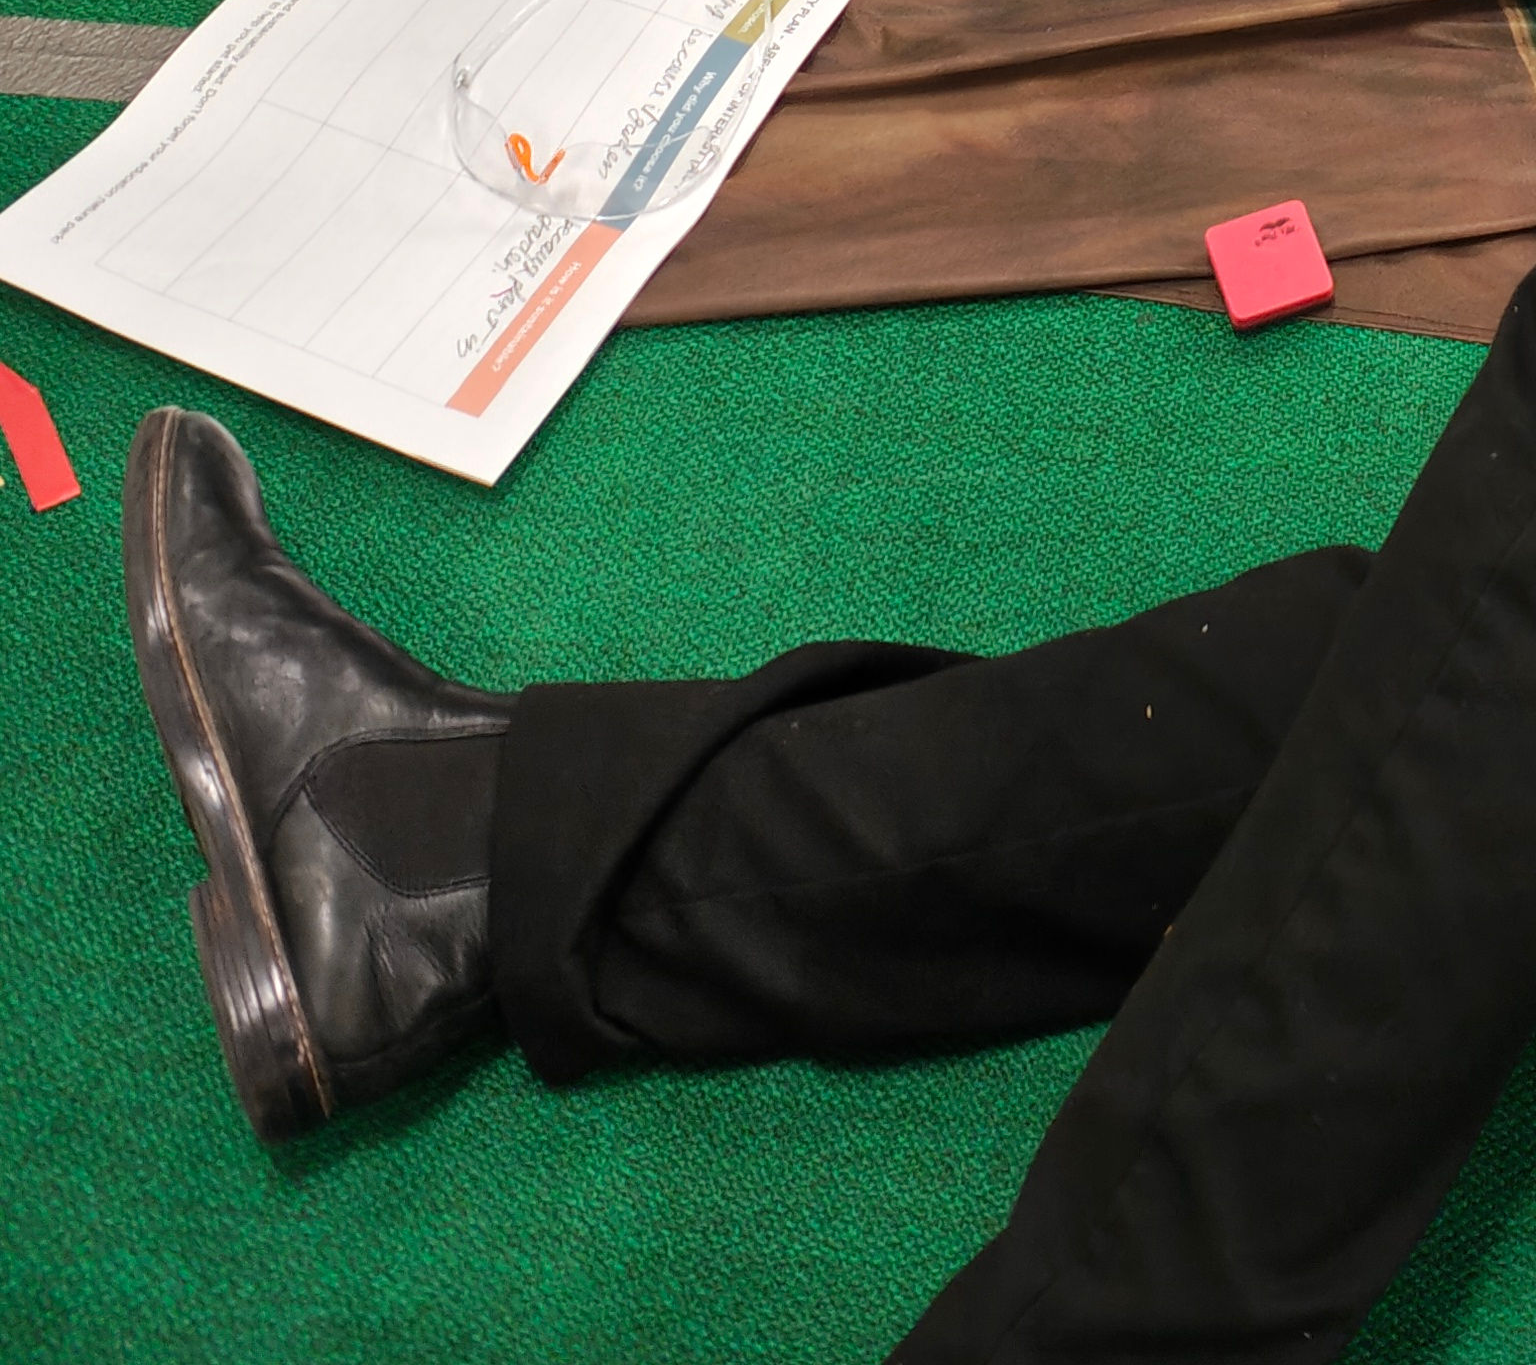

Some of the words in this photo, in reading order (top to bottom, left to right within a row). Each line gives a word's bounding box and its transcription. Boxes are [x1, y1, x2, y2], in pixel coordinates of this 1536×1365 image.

[247, 5, 272, 31] help
[267, 0, 281, 13] to
[784, 8, 810, 34] PLAN
[230, 9, 285, 63] sustainability
[231, 24, 254, 47] you
[217, 42, 237, 61] get
[189, 57, 224, 93] started.
[692, 70, 716, 93] Why
[193, 88, 217, 114] Don't
[681, 93, 701, 115] did
[162, 109, 197, 145] forget
[666, 111, 685, 134] you
[144, 137, 171, 164] your
[640, 132, 674, 175] choose
[106, 159, 150, 202] education
[630, 173, 649, 193] it?
[73, 196, 107, 226] nature
[557, 258, 583, 288] How
[541, 294, 553, 308] it
[547, 283, 562, 299] is
[491, 302, 544, 375] sustainable?
